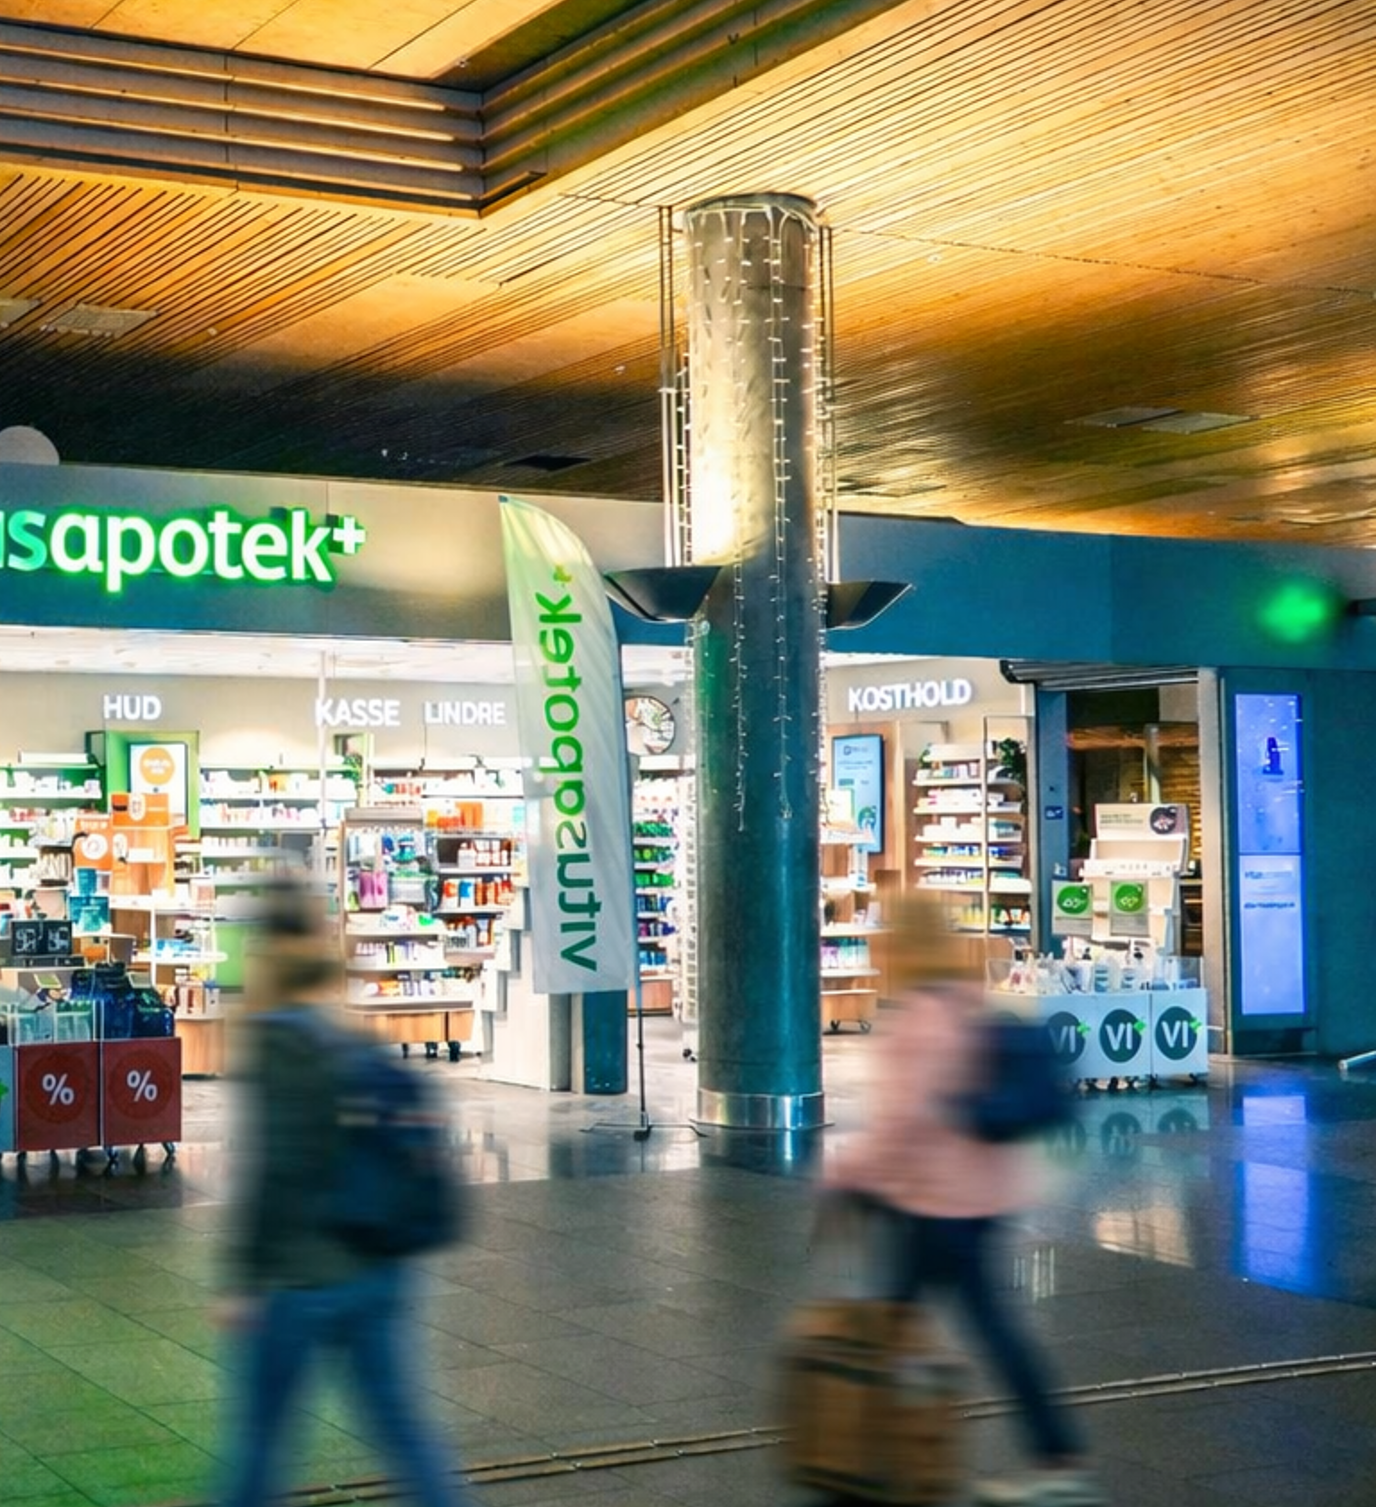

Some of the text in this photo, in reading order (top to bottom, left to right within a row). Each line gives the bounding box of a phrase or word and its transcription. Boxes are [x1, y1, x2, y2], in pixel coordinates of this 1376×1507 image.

[104, 695, 162, 720] HUD
[848, 678, 972, 712] KOSTHOLD
[315, 698, 401, 726] KASSE
[425, 701, 506, 725] LINDRE
[42, 1073, 74, 1105] %
[126, 1069, 158, 1102] %
